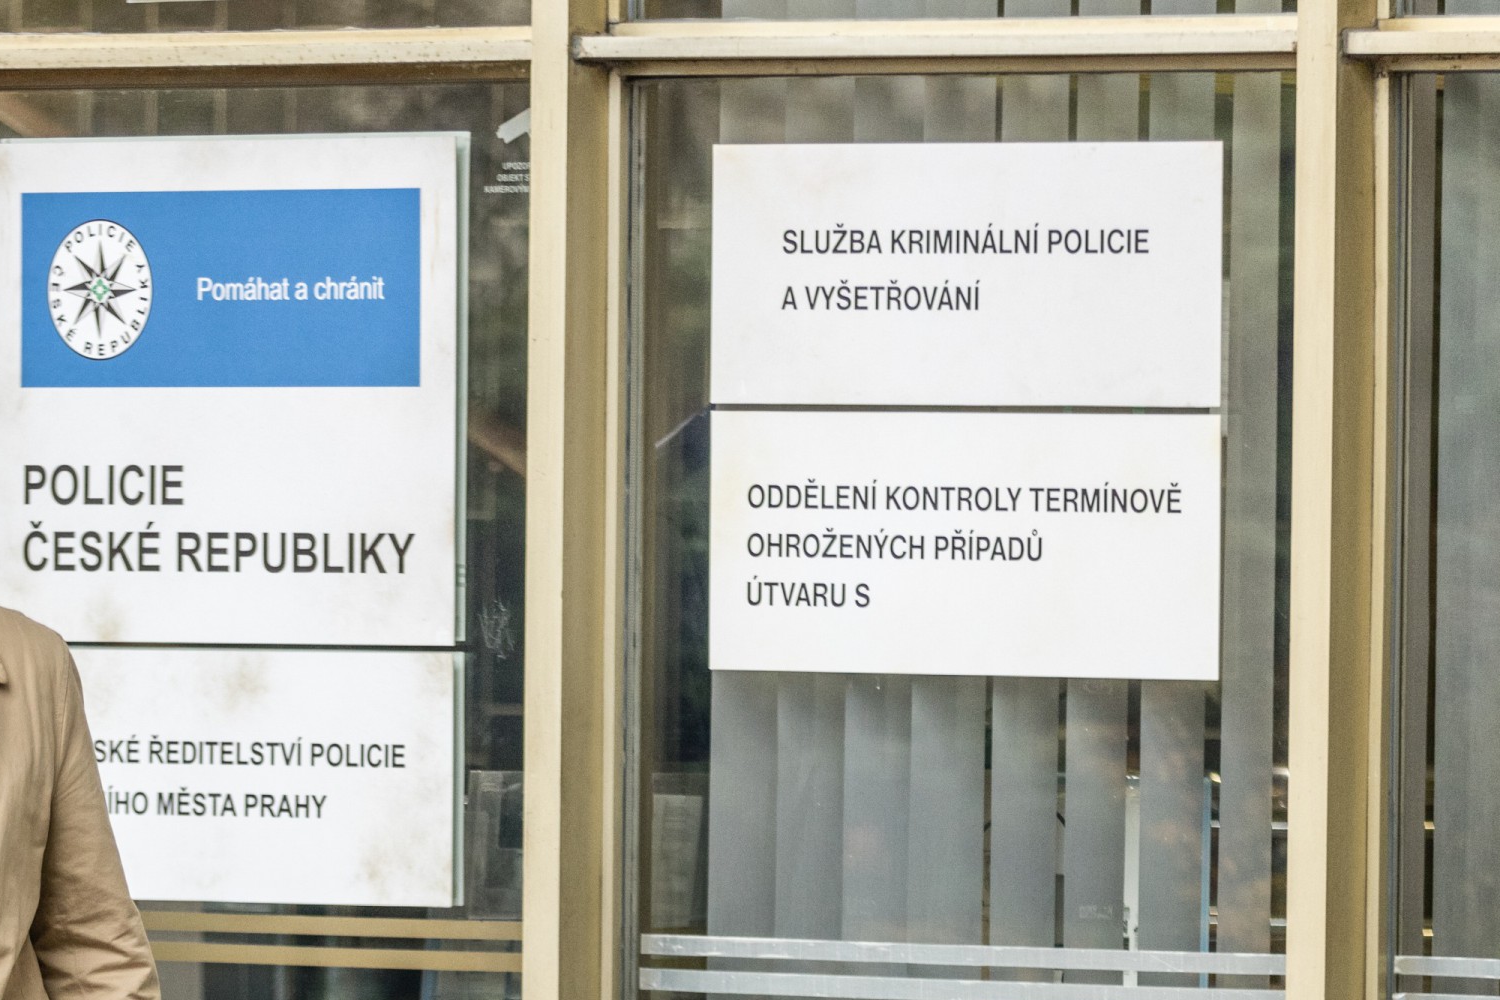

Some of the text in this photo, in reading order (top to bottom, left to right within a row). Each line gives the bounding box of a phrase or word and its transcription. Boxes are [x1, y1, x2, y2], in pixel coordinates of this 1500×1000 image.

[501, 161, 530, 170] UPOZO
[64, 223, 137, 253] POLICIE
[782, 222, 1150, 255] SLUŽBA KRIMINÁLNÍ POLICIE
[196, 275, 386, 302] Pomáhat a chránit
[781, 279, 980, 311] A VYŠETŘOVÁNÍ
[84, 263, 149, 357] REPUBLIKY
[24, 464, 184, 506] POLICIE
[747, 478, 1182, 514] ODDĚLENÍ KONTROLY TERMÍNOVĚ
[22, 520, 416, 575] ČESKÉ REPUBLIKY
[746, 527, 1043, 562] OHROŽENÝCH PŘÍPADŮ
[747, 574, 870, 609] ÚTVARU S
[93, 734, 406, 769] SKÉ ŘEDITELSTVÍ POLICIE
[108, 784, 327, 819] ÍHO MĚSTA PRAHY
